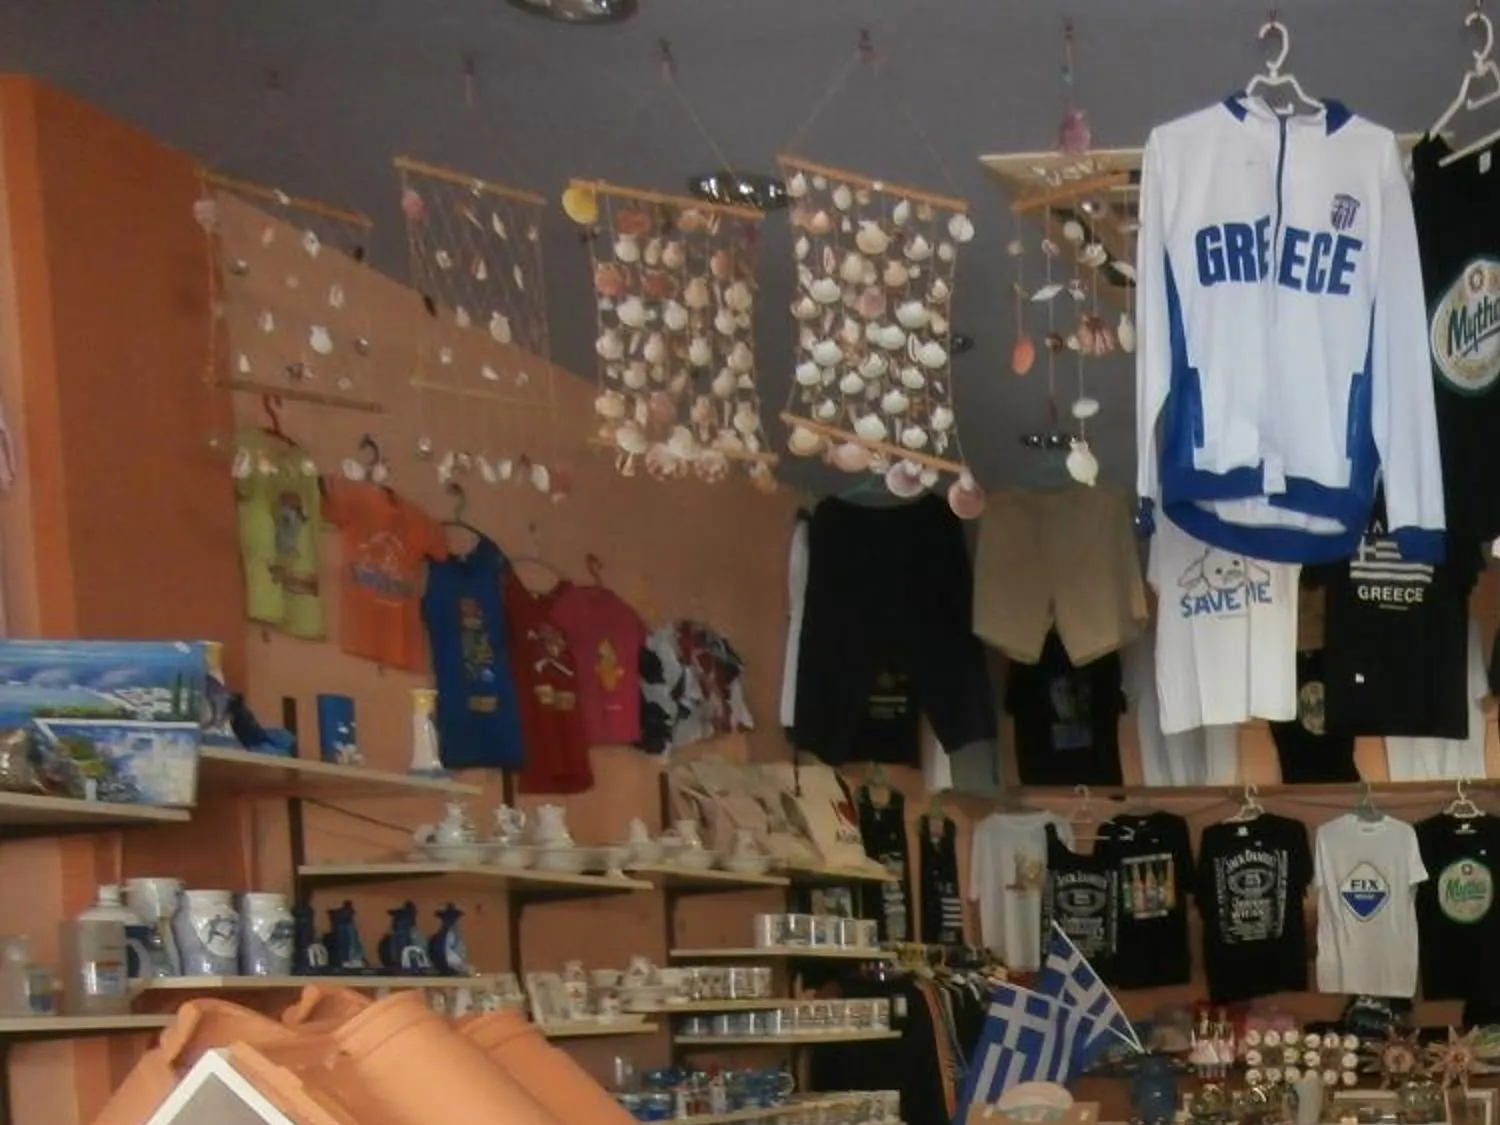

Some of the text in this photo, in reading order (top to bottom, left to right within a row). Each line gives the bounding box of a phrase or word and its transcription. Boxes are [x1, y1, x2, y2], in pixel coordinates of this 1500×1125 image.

[1195, 214, 1363, 296] GREECE
[1180, 587, 1242, 618] SAVE
[1357, 584, 1425, 604] GREECE
[1351, 879, 1379, 891] FIX
